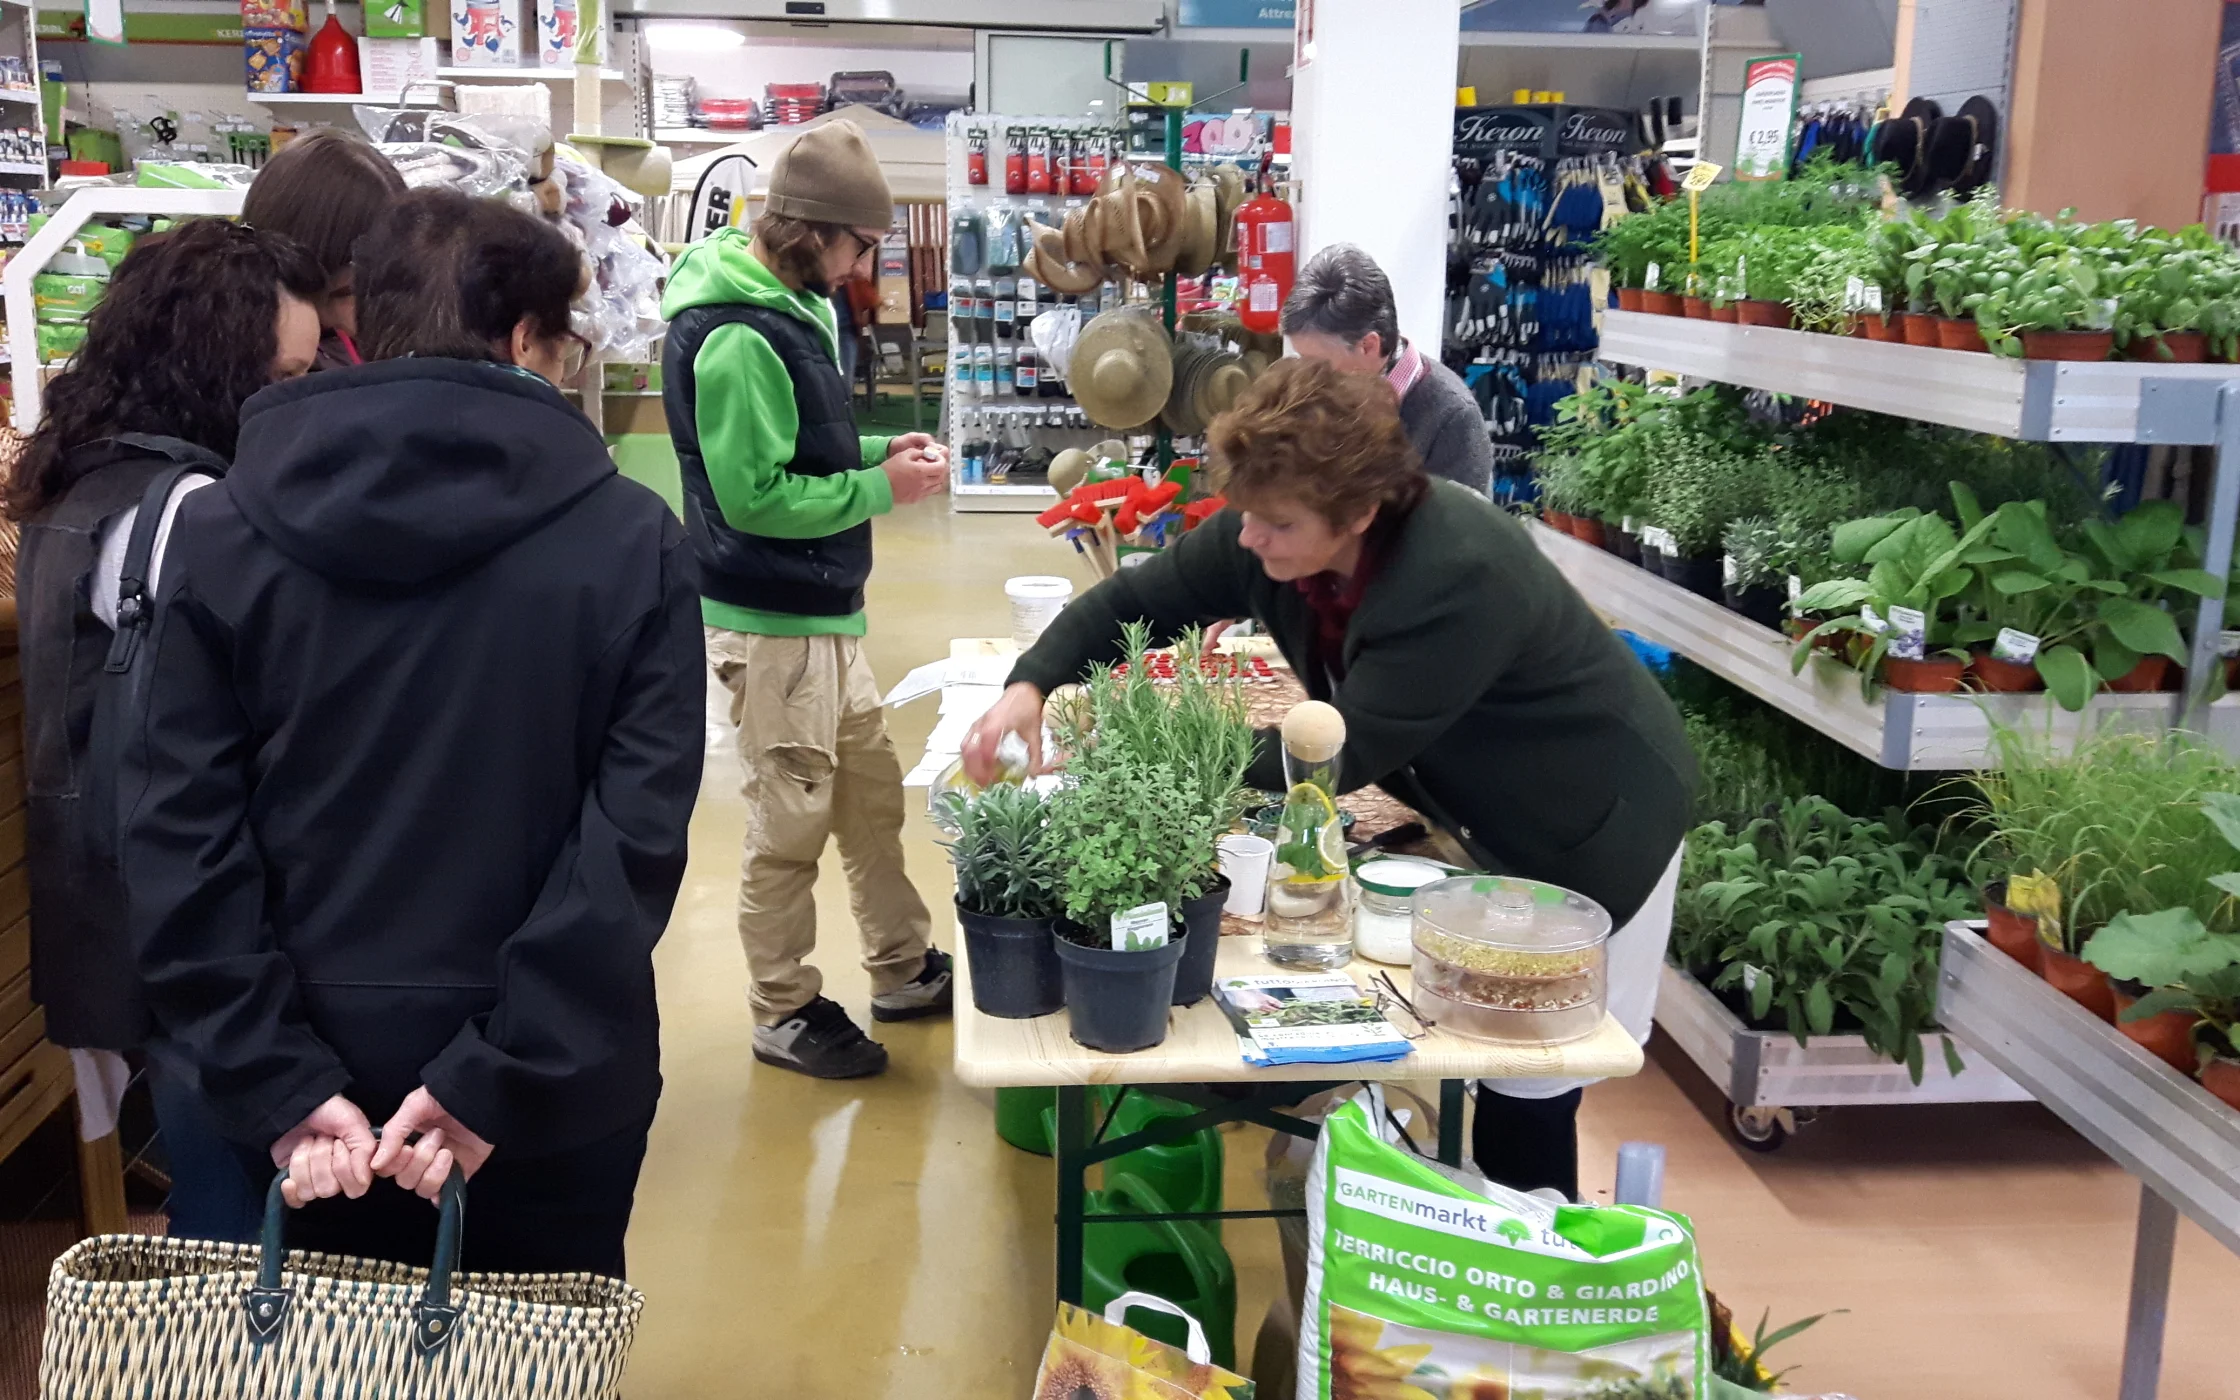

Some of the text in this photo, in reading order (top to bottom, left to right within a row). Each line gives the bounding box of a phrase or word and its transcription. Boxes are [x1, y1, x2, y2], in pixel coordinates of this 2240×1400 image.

[1259, 7, 1295, 19] Attre
[1454, 115, 1545, 142] Keron
[1561, 114, 1627, 143] Keron
[704, 186, 732, 237] ER
[1340, 1182, 1487, 1232] GARTENmarkt
[1334, 1228, 1690, 1300] TERRICCIO ORTO & GIARDINO
[1368, 1271, 1660, 1326] HAUS- & GARTENERDE
